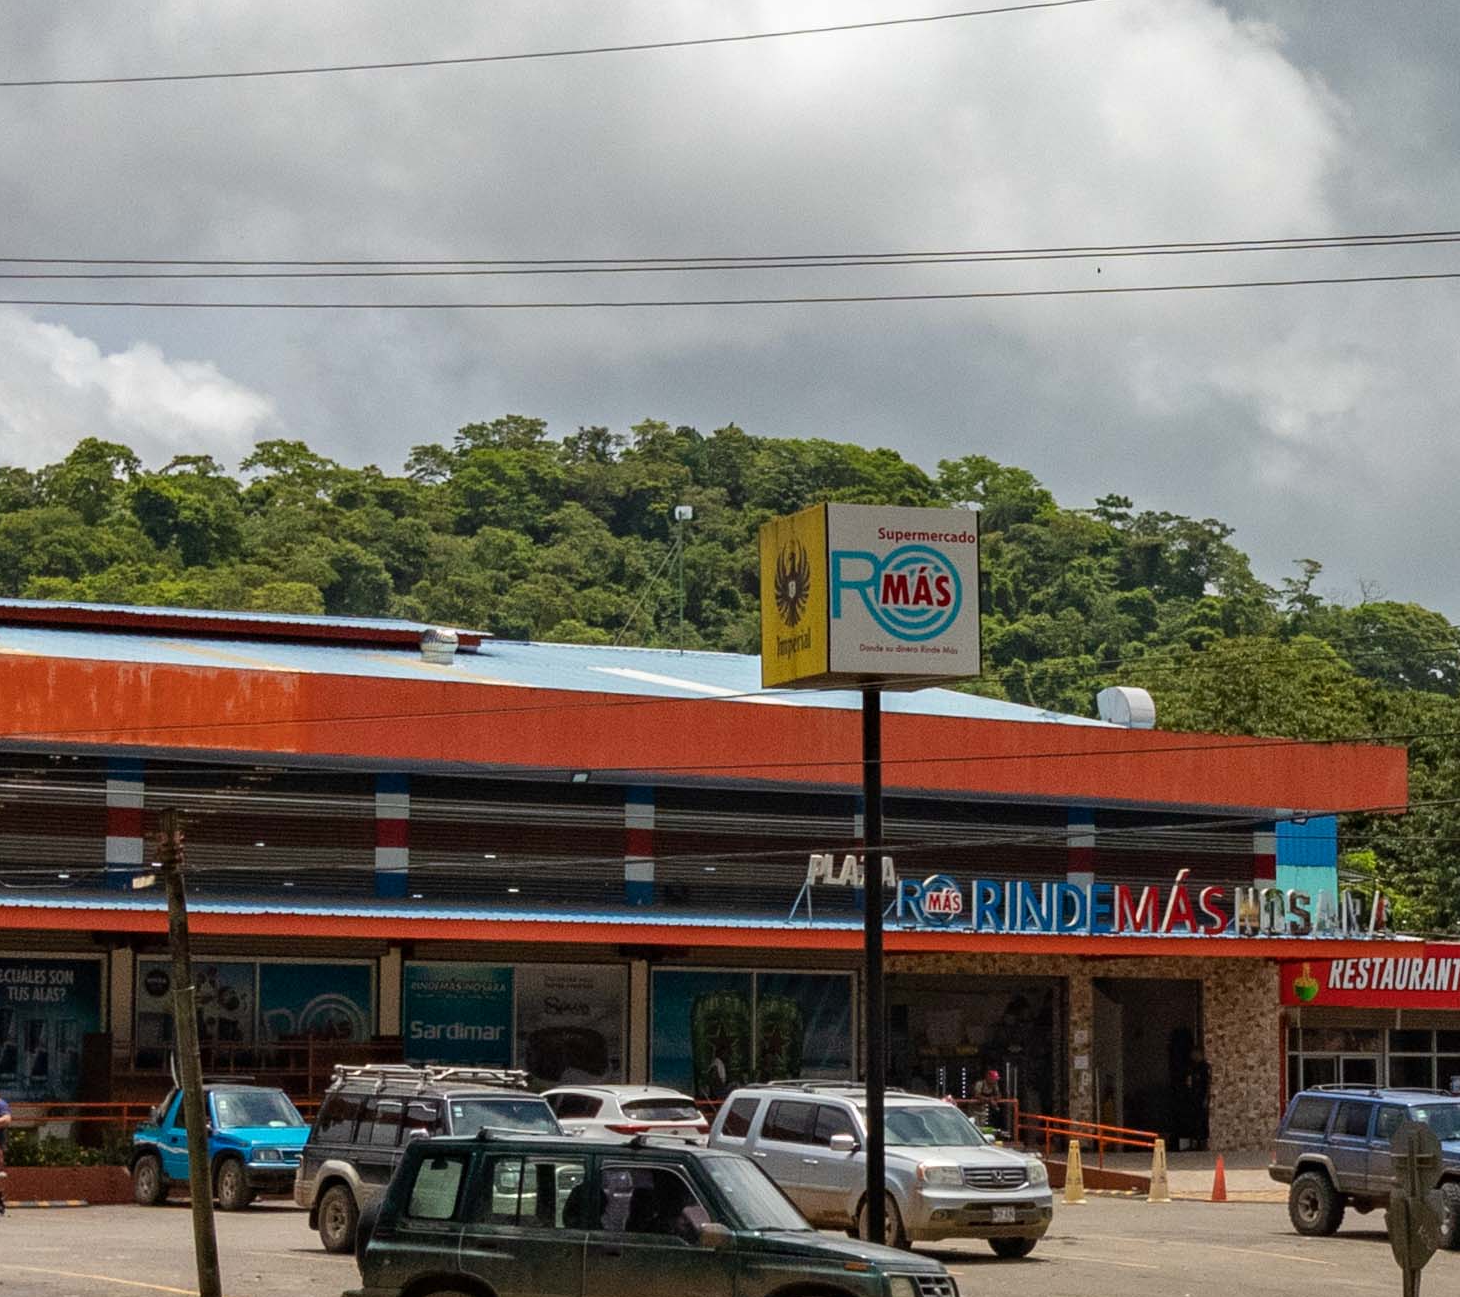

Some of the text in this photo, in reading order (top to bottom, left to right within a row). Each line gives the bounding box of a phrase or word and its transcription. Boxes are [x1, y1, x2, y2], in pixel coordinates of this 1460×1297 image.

[878, 527, 976, 544] Supermercado
[881, 566, 951, 607] MÁS
[776, 627, 811, 658] Imperial
[859, 643, 883, 653] Donde
[895, 644, 918, 653] dinero
[920, 645, 940, 654] Rinde
[942, 645, 958, 654] Más
[807, 854, 896, 887] PLAA
[927, 888, 961, 913] MÁS
[49, 969, 75, 985] SON
[8, 986, 67, 1002] TUS ALAS?
[410, 1020, 506, 1040] Sardimar
